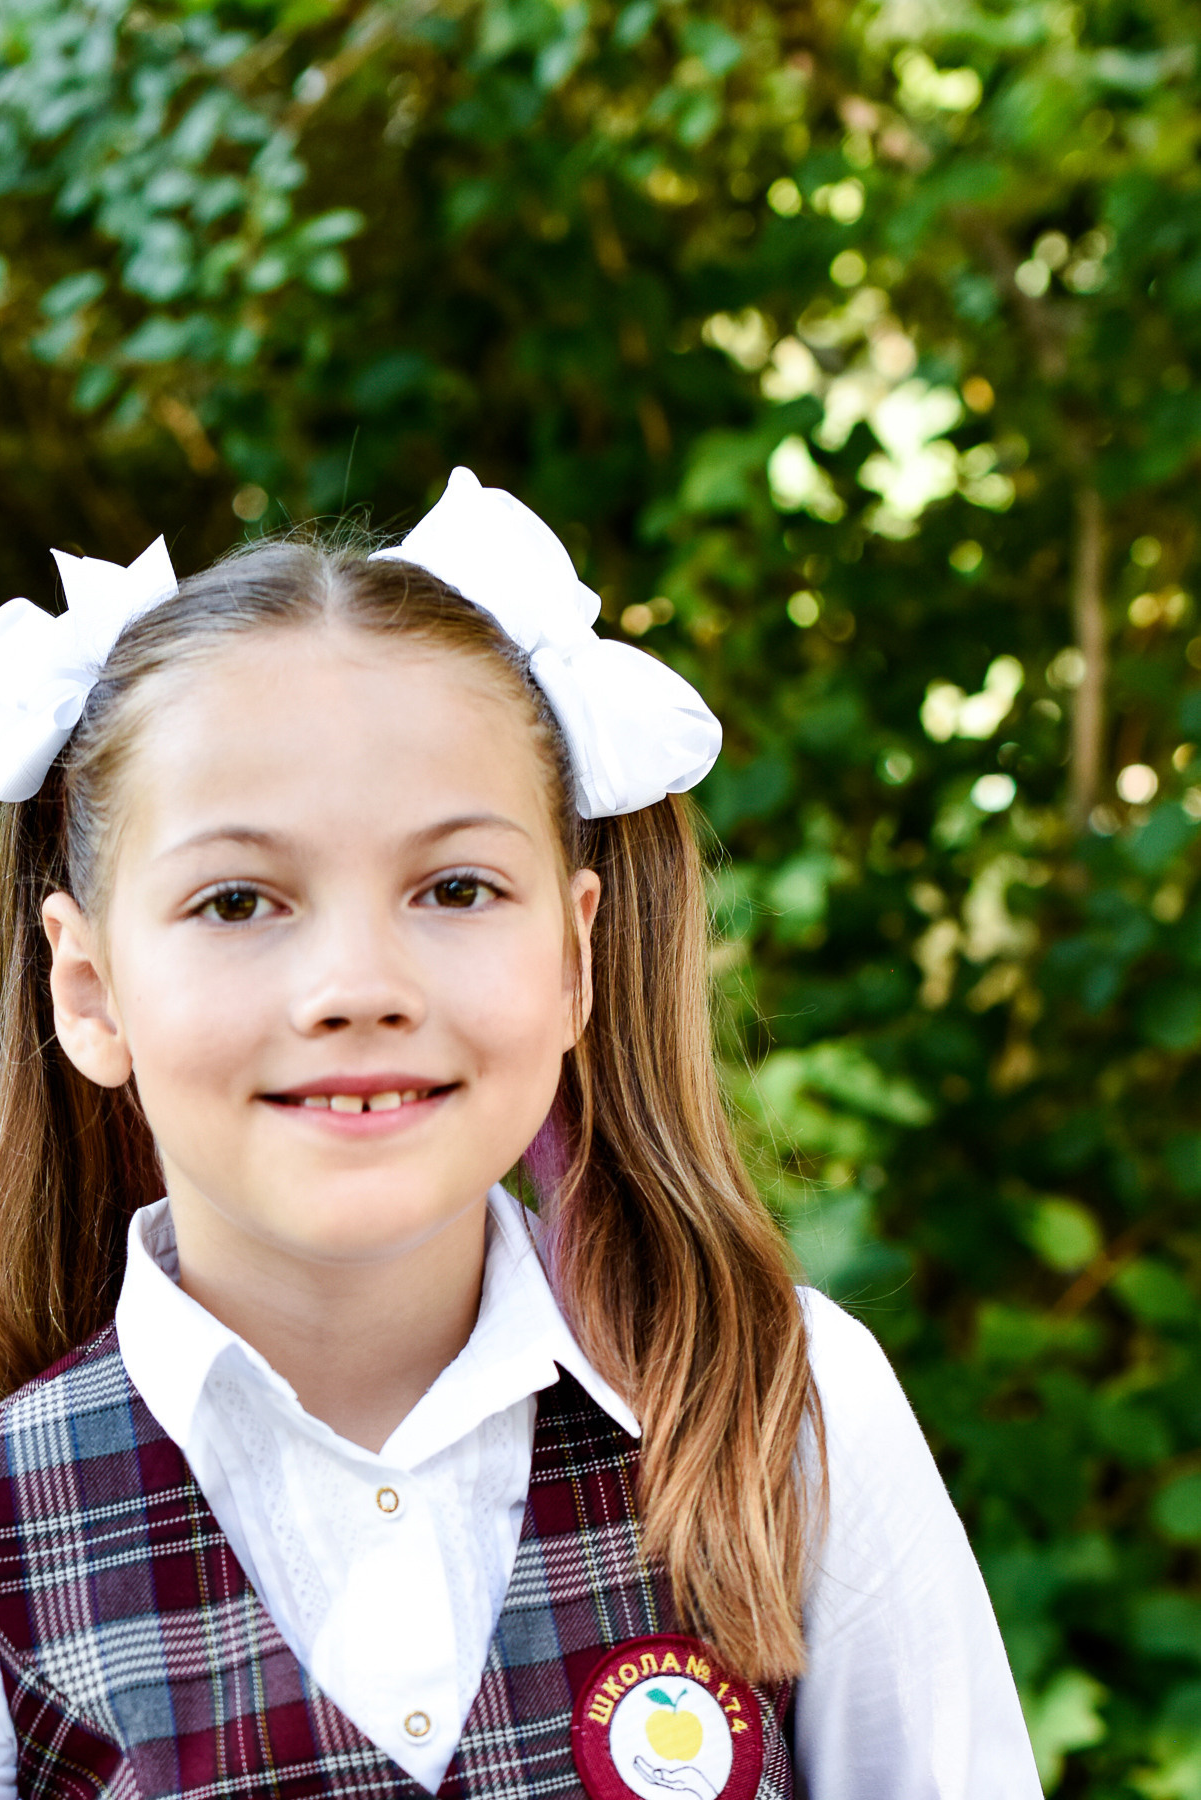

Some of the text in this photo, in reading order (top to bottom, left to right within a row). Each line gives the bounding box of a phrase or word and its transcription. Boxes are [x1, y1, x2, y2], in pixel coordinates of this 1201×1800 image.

[587, 1651, 749, 1734] ШКОЛА № 174
